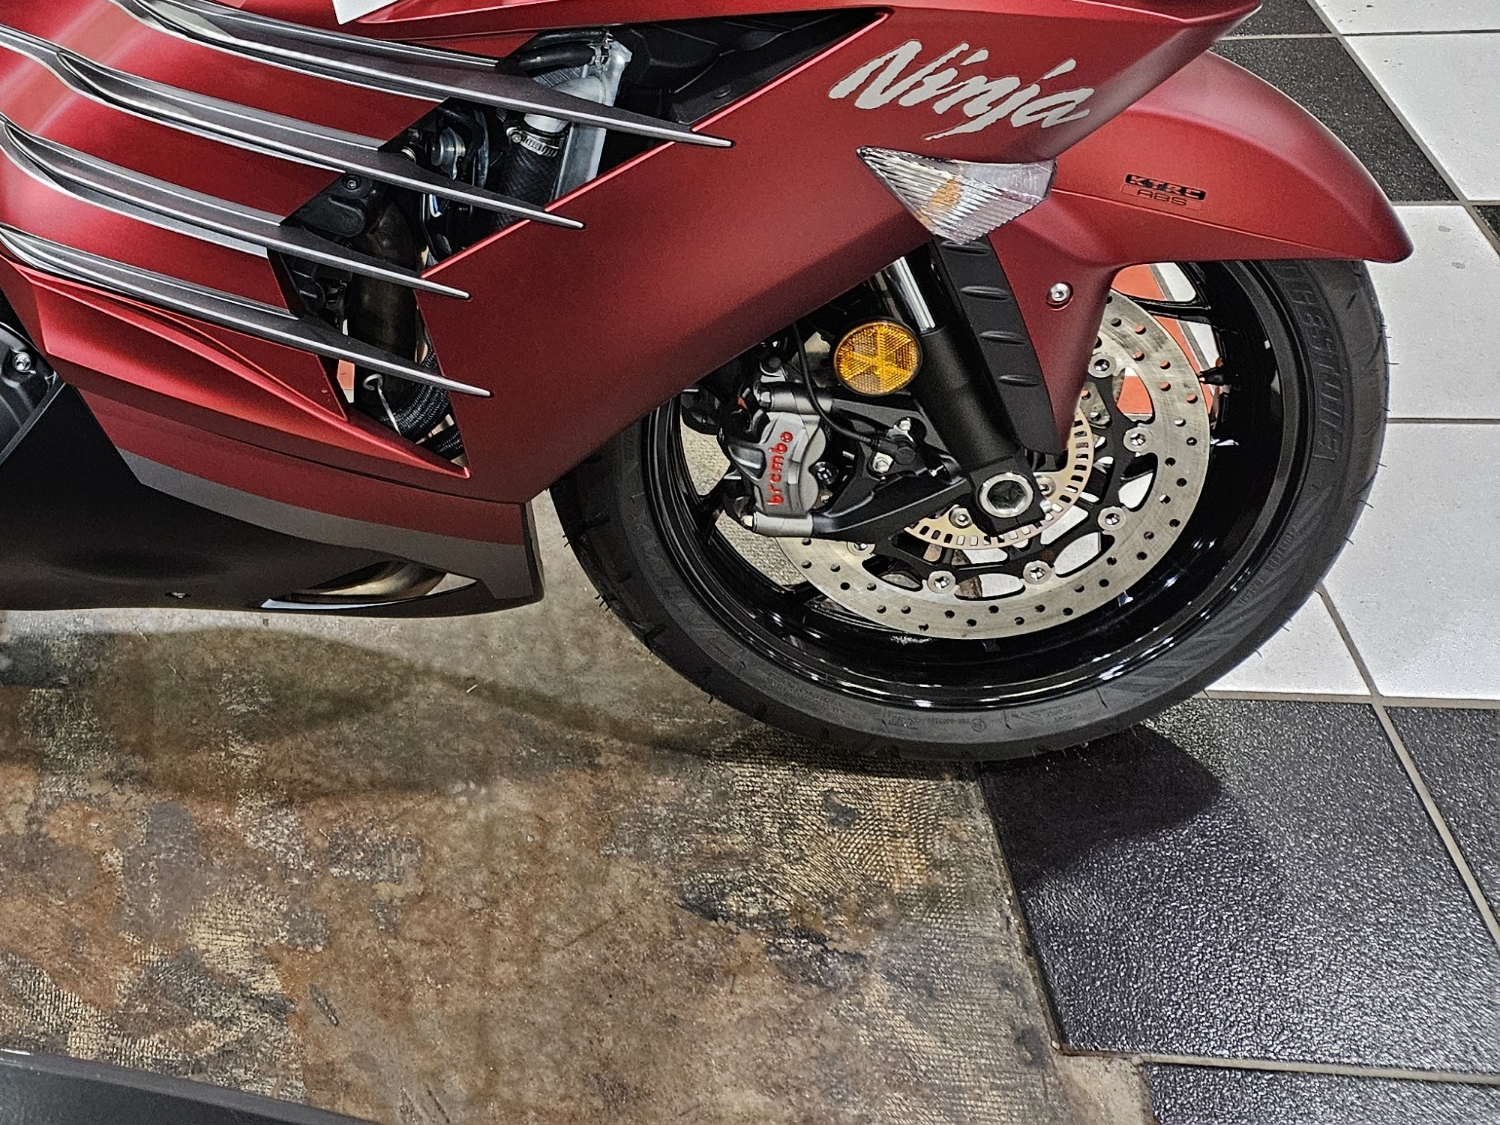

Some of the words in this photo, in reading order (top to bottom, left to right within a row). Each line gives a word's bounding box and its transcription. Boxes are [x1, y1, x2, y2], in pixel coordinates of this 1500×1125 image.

[828, 38, 1095, 142] Ninja
[1129, 175, 1202, 200] KTRC
[1137, 189, 1188, 207] ABS
[765, 431, 794, 506] brembo
